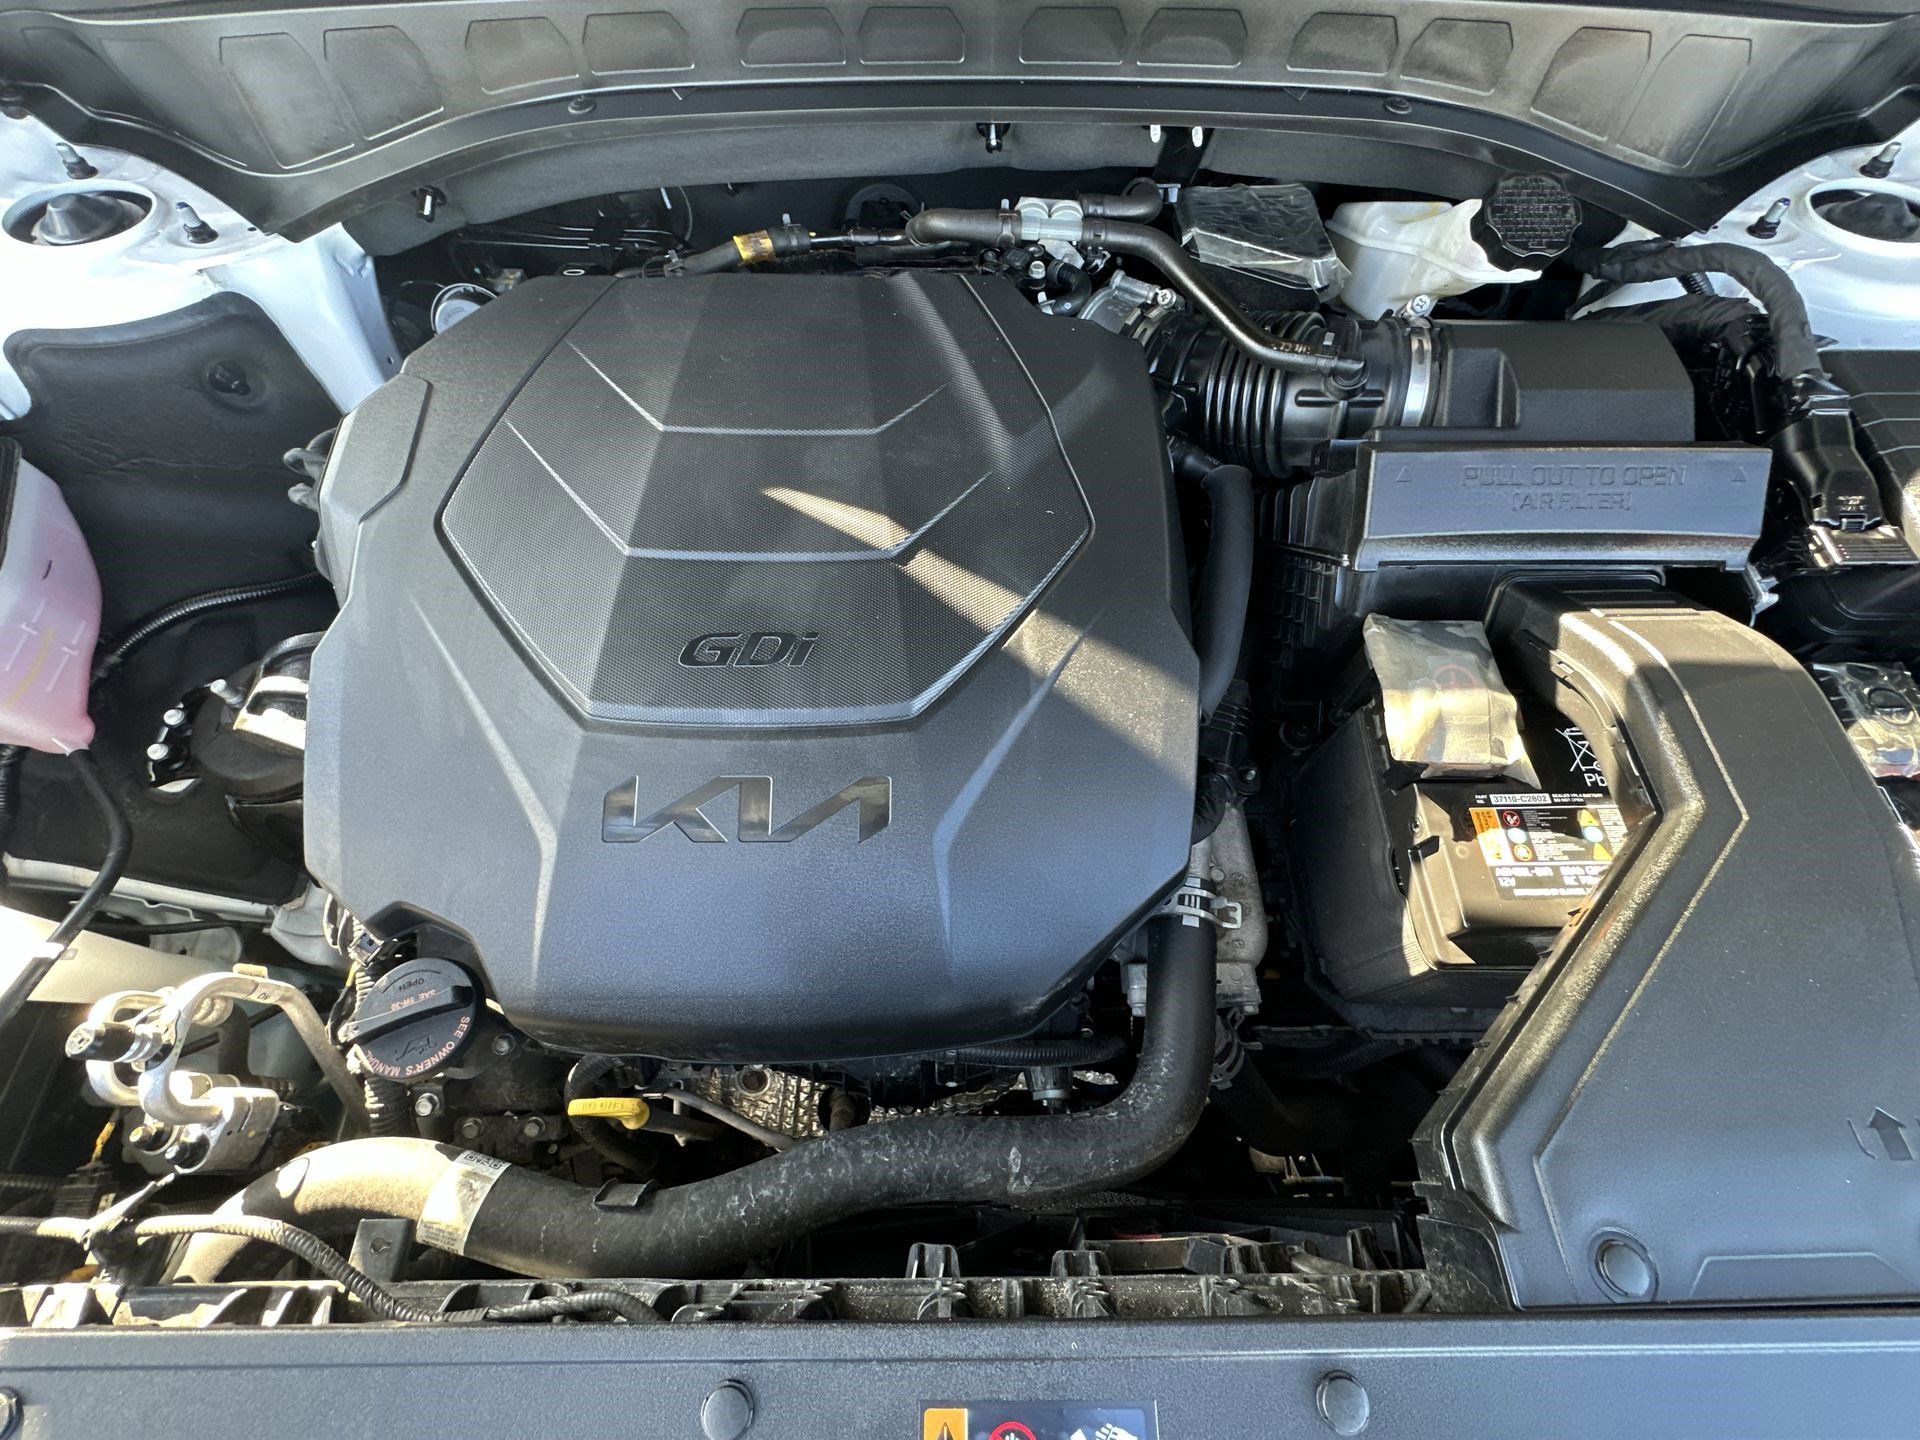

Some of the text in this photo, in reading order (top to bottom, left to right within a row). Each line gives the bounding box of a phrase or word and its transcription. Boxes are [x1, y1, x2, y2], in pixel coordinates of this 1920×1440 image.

[1460, 464, 1687, 487] PULL OUT TO OPEN
[678, 632, 820, 668] GDi
[1583, 773, 1608, 787] Pb
[399, 977, 425, 991] OPEN
[366, 1015, 471, 1077] SEE OWNER'S MANUAL
